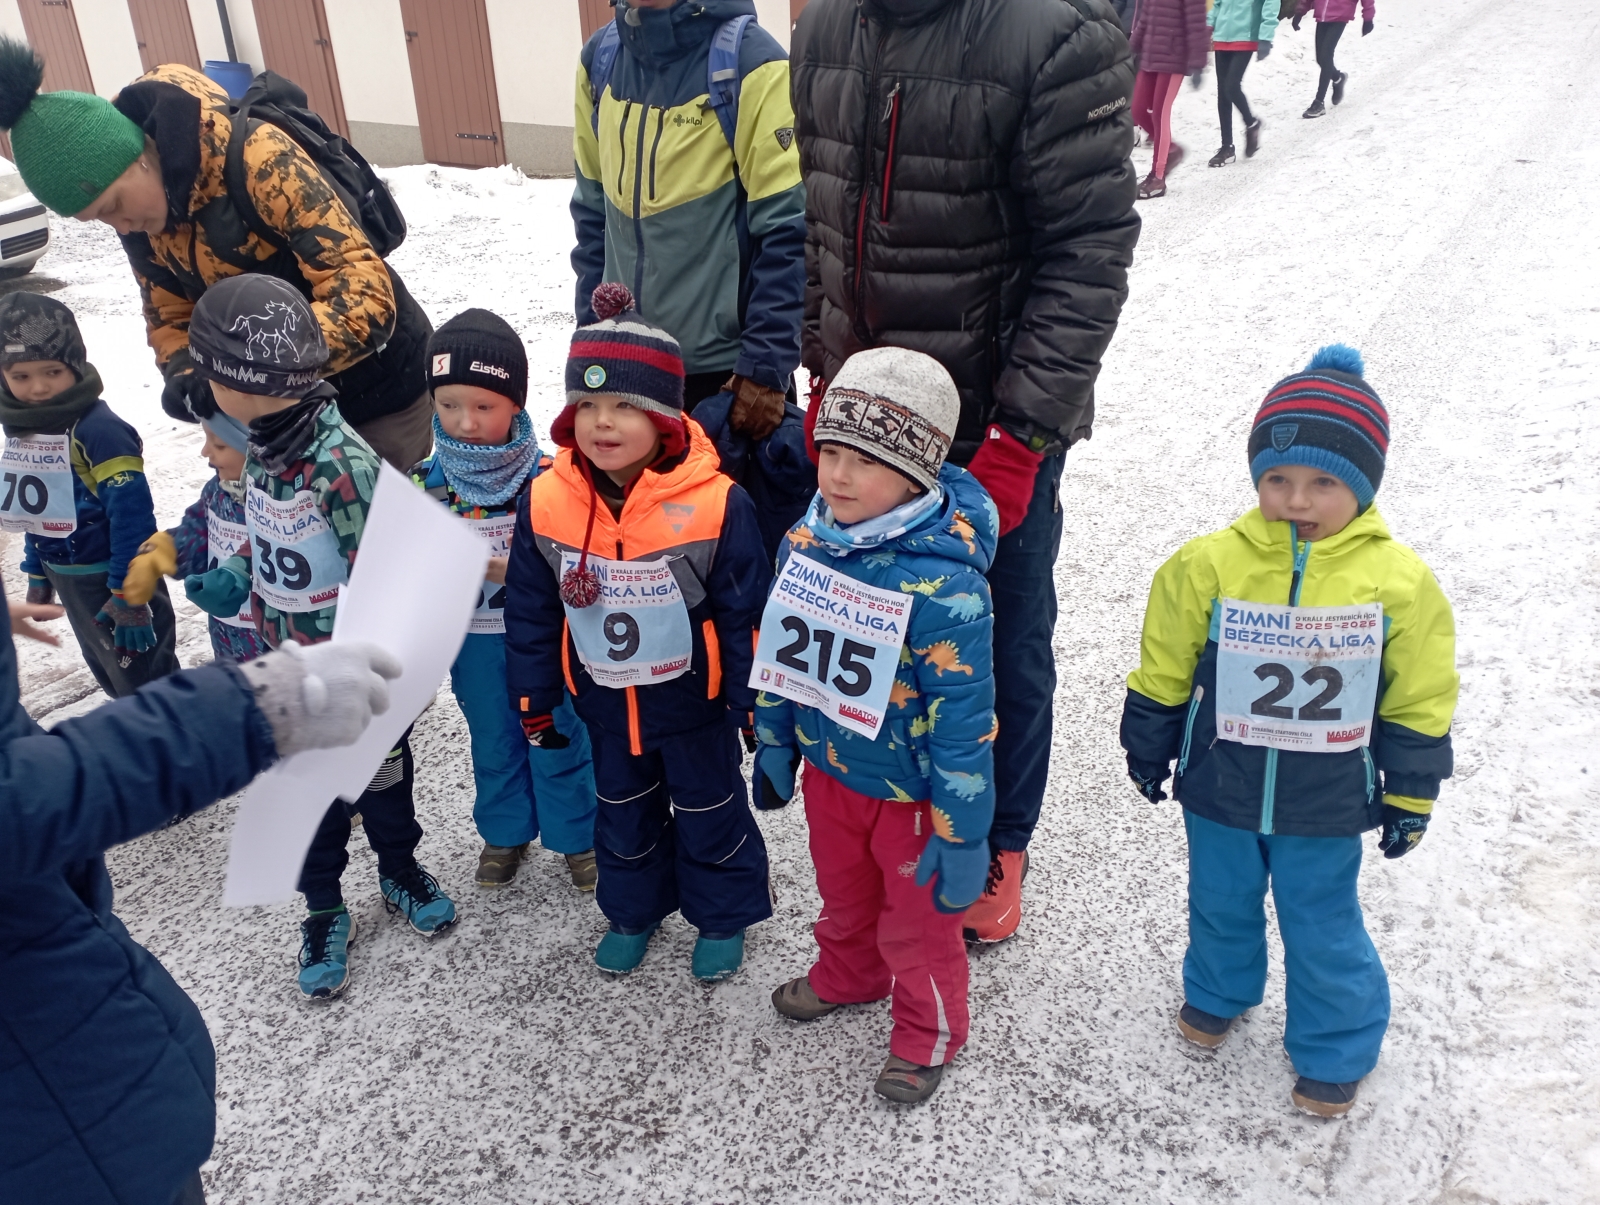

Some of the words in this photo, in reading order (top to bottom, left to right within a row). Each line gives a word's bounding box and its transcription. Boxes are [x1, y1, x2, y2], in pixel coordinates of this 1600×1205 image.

[1087, 96, 1126, 119] NORTHLAND
[685, 117, 703, 126] kilpi
[469, 360, 510, 380] Eisbär
[32, 454, 66, 464] LIGA
[1, 472, 48, 515] 70
[42, 521, 73, 531] MARATON
[282, 513, 320, 536] LIGA
[255, 534, 312, 591] 39
[634, 567, 665, 575] JESTŘEBÍCH
[786, 560, 834, 593] ZIMNÍ
[641, 581, 678, 597] LIGA
[839, 582, 856, 594] KRÁLE
[856, 590, 890, 605] JESTŘEBÍCH
[890, 600, 905, 608] HOR
[779, 578, 850, 621] BĚŽECKÁ
[854, 610, 899, 635] LIGA
[832, 586, 904, 616] 2025-2026
[1225, 607, 1292, 630] ZIMNÍ
[1295, 620, 1377, 630] 2025-2026
[1302, 614, 1324, 622] KRÁLE
[1325, 613, 1363, 622] JESTŘEBÍCH
[1363, 612, 1377, 620] HOR
[603, 611, 640, 662] 9
[1224, 627, 1324, 649] BĚŽECKÁ
[1329, 633, 1377, 649] LIGA
[650, 657, 688, 676] MARATON
[775, 615, 877, 698] 215
[1251, 662, 1344, 721] 22
[838, 702, 880, 727] MARATON
[1326, 725, 1366, 743] MARATON
